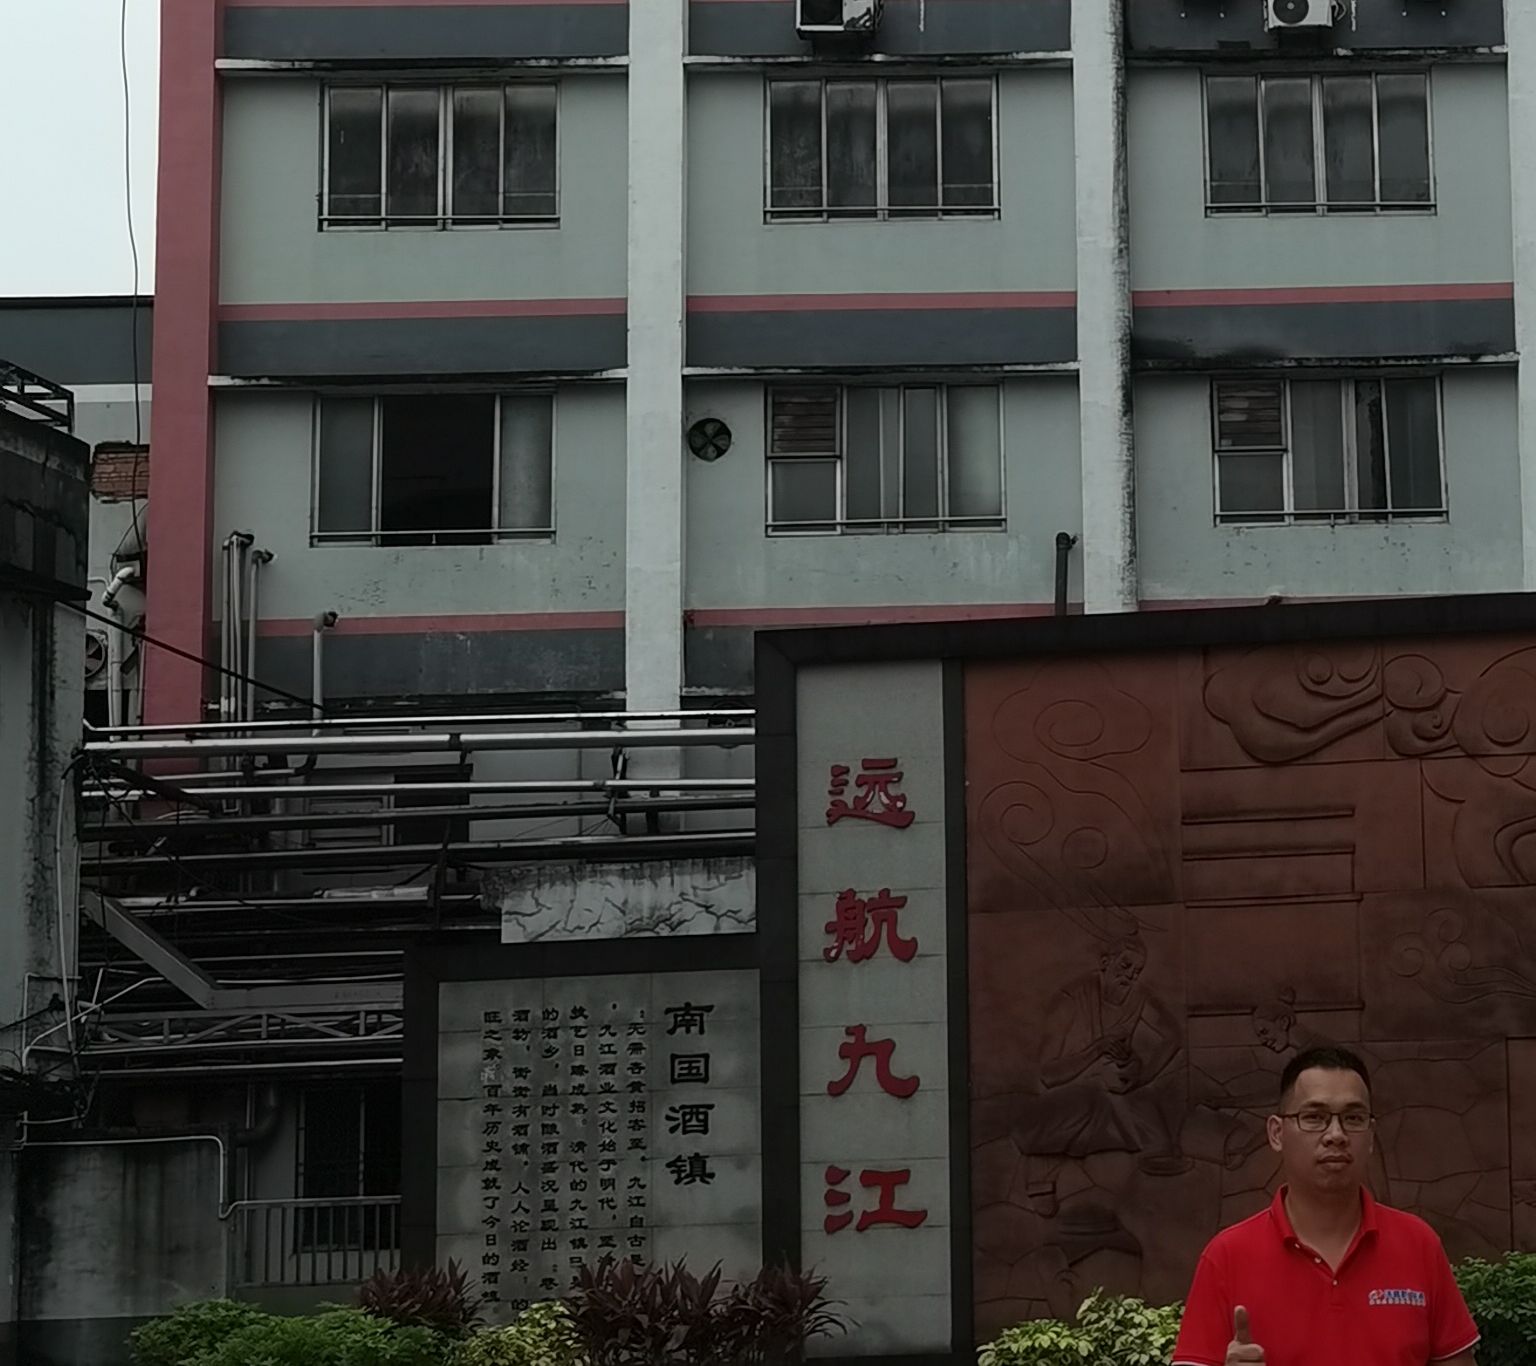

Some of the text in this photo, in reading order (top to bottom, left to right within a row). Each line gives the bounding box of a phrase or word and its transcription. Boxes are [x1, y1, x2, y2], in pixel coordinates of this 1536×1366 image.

[663, 1001, 716, 1186] 南国酒镇
[824, 757, 929, 1235] 远航九江
